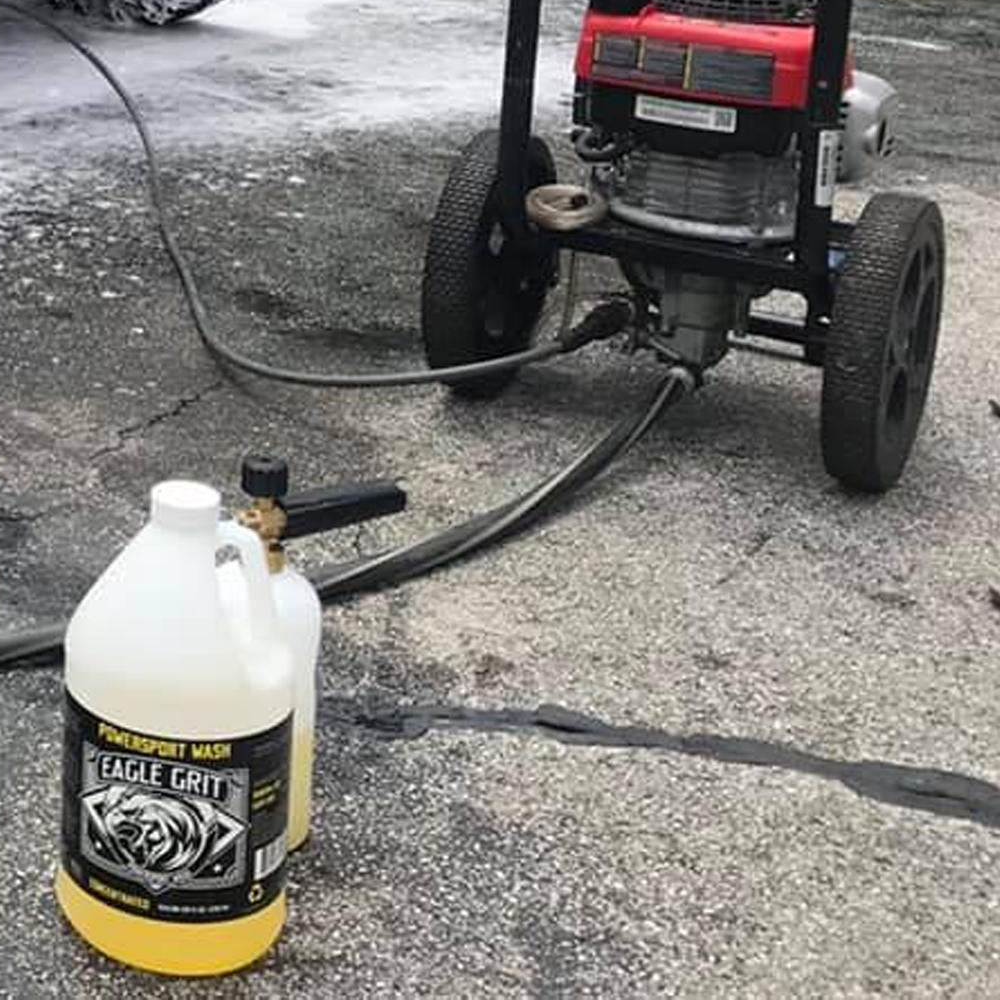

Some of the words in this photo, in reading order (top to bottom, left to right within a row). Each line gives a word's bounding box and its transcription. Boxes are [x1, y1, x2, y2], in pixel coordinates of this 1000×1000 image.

[191, 743, 232, 761] WASH
[101, 756, 162, 786] EAGLE
[170, 768, 223, 799] GRIT
